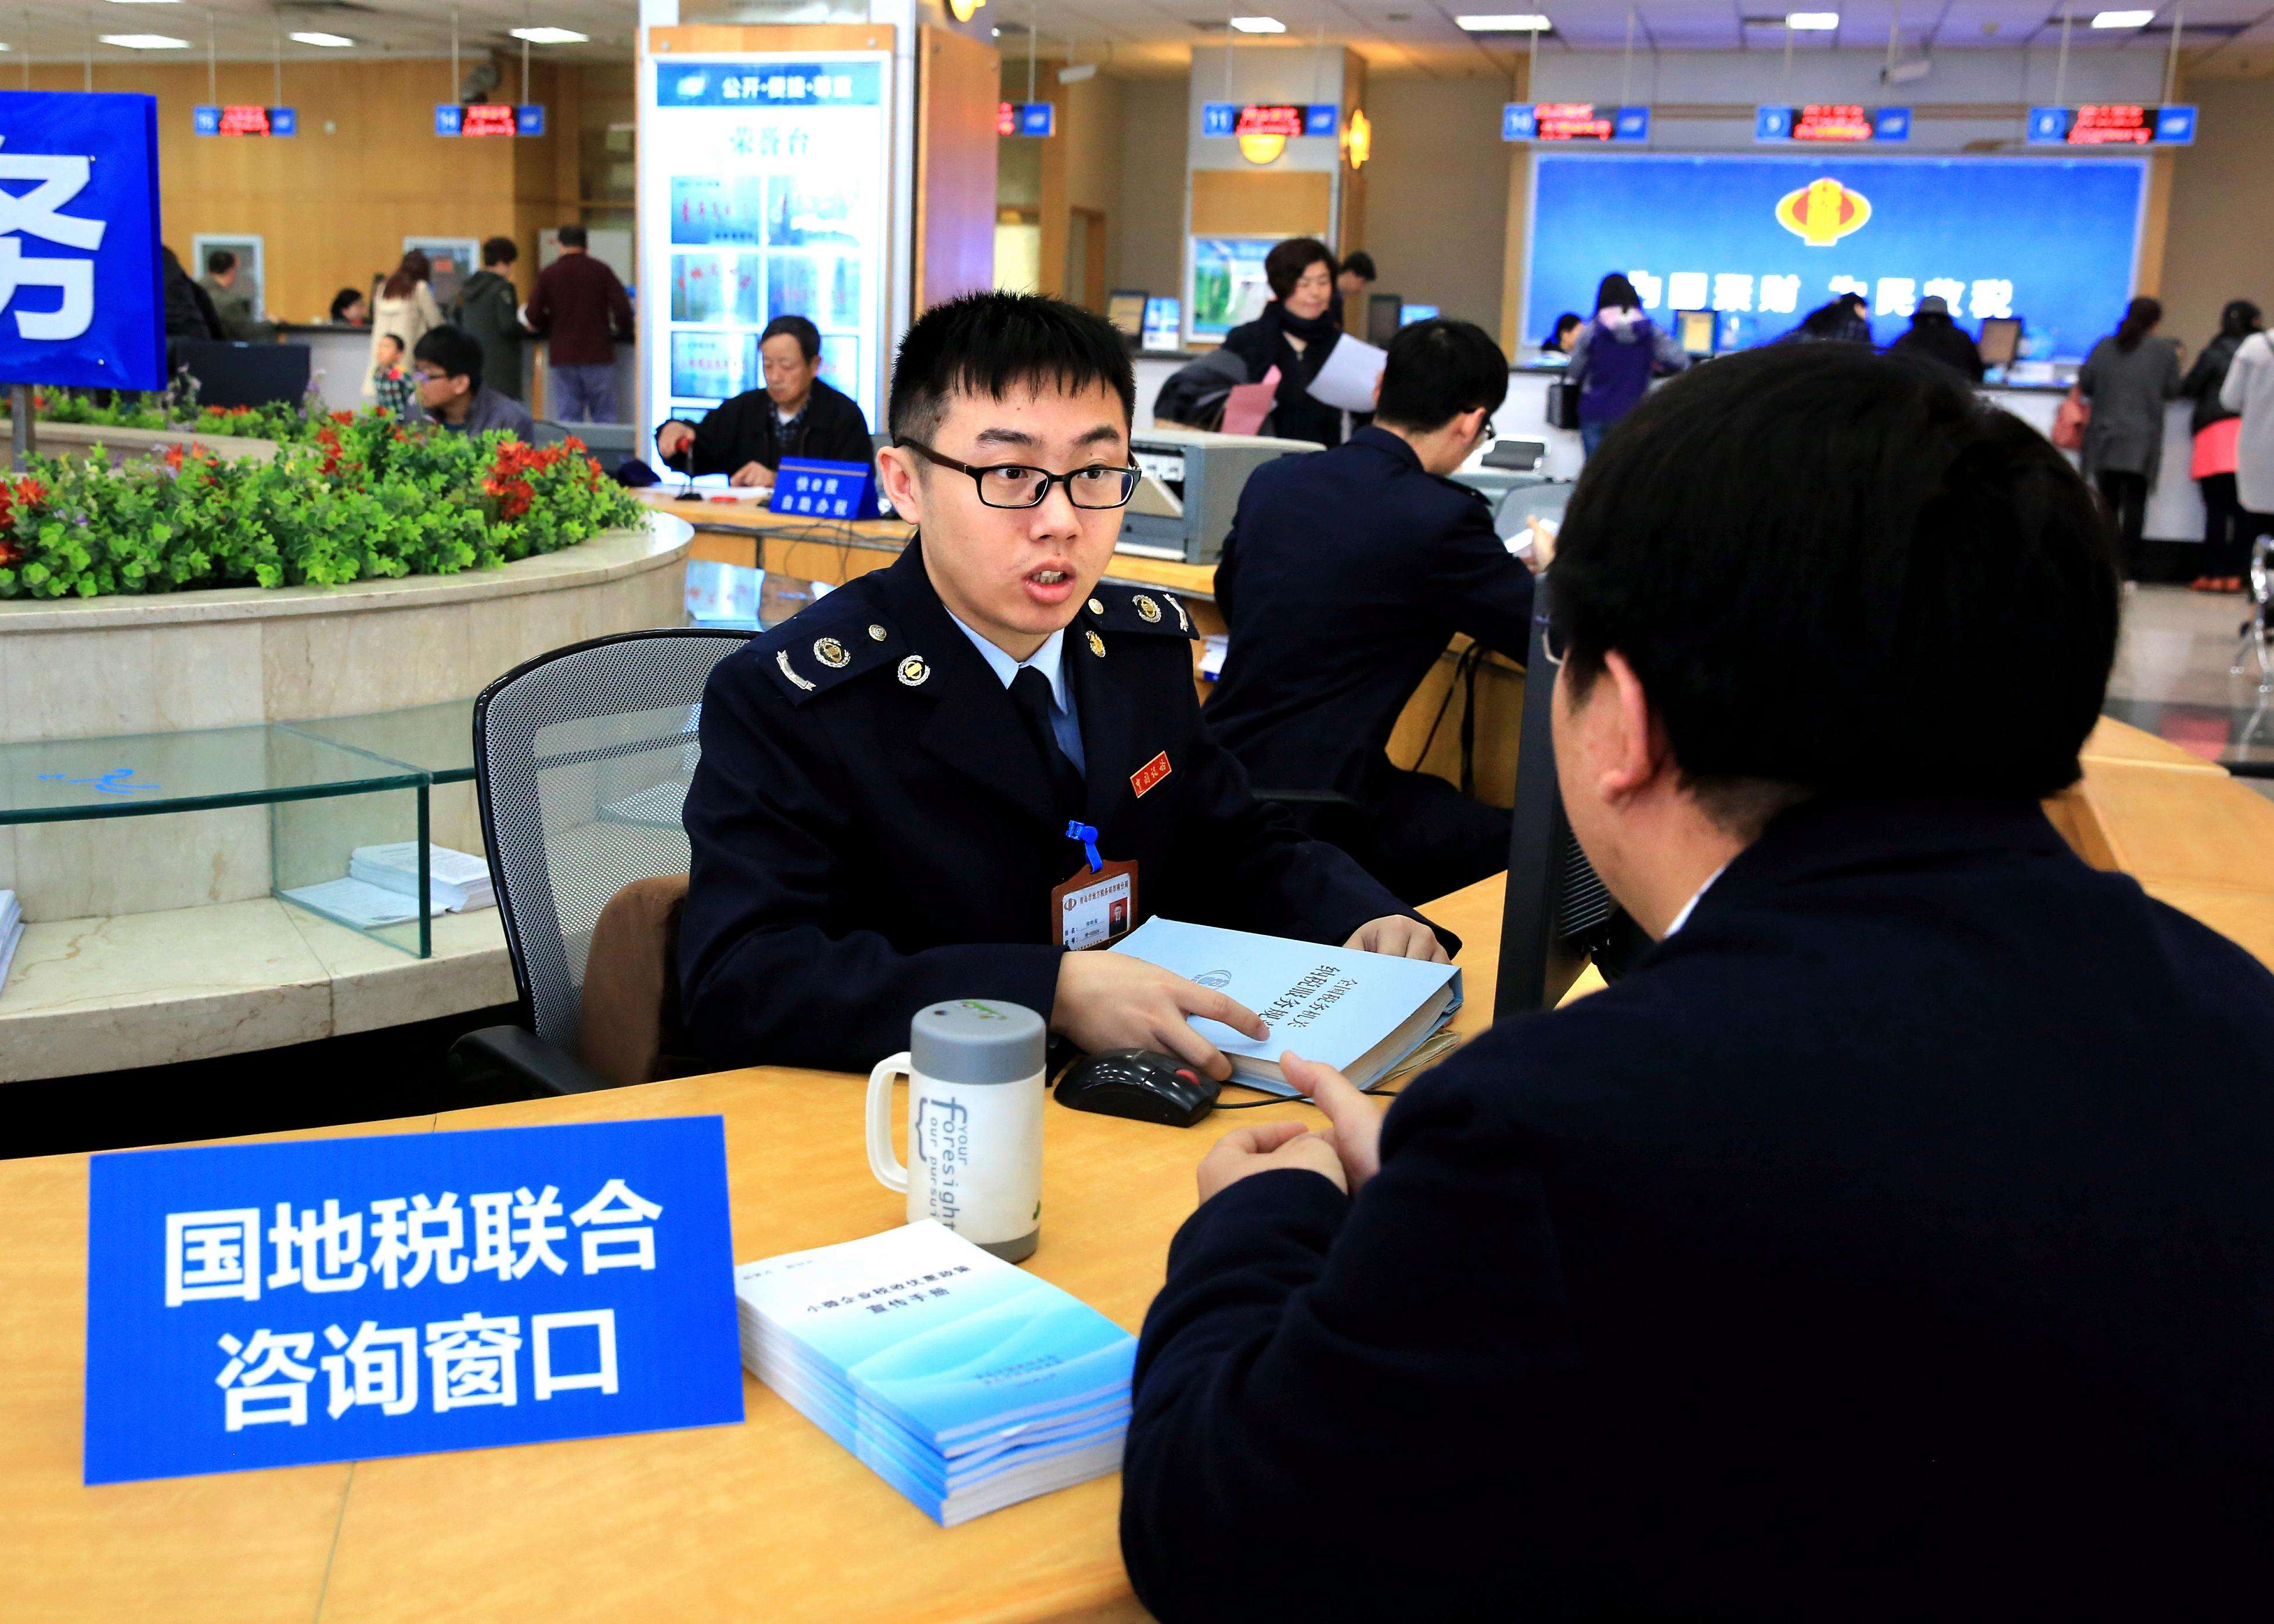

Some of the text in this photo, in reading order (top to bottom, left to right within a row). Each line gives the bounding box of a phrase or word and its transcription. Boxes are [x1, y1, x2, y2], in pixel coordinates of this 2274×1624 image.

[1208, 110, 1228, 128] 11
[1287, 977, 1358, 1028] 全国税务机关
[930, 1117, 940, 1218] our pursui
[931, 1096, 968, 1231] foresight
[957, 1125, 969, 1166] your
[164, 1178, 664, 1308] 国地税联合
[214, 1308, 620, 1433] 咨询窗口
